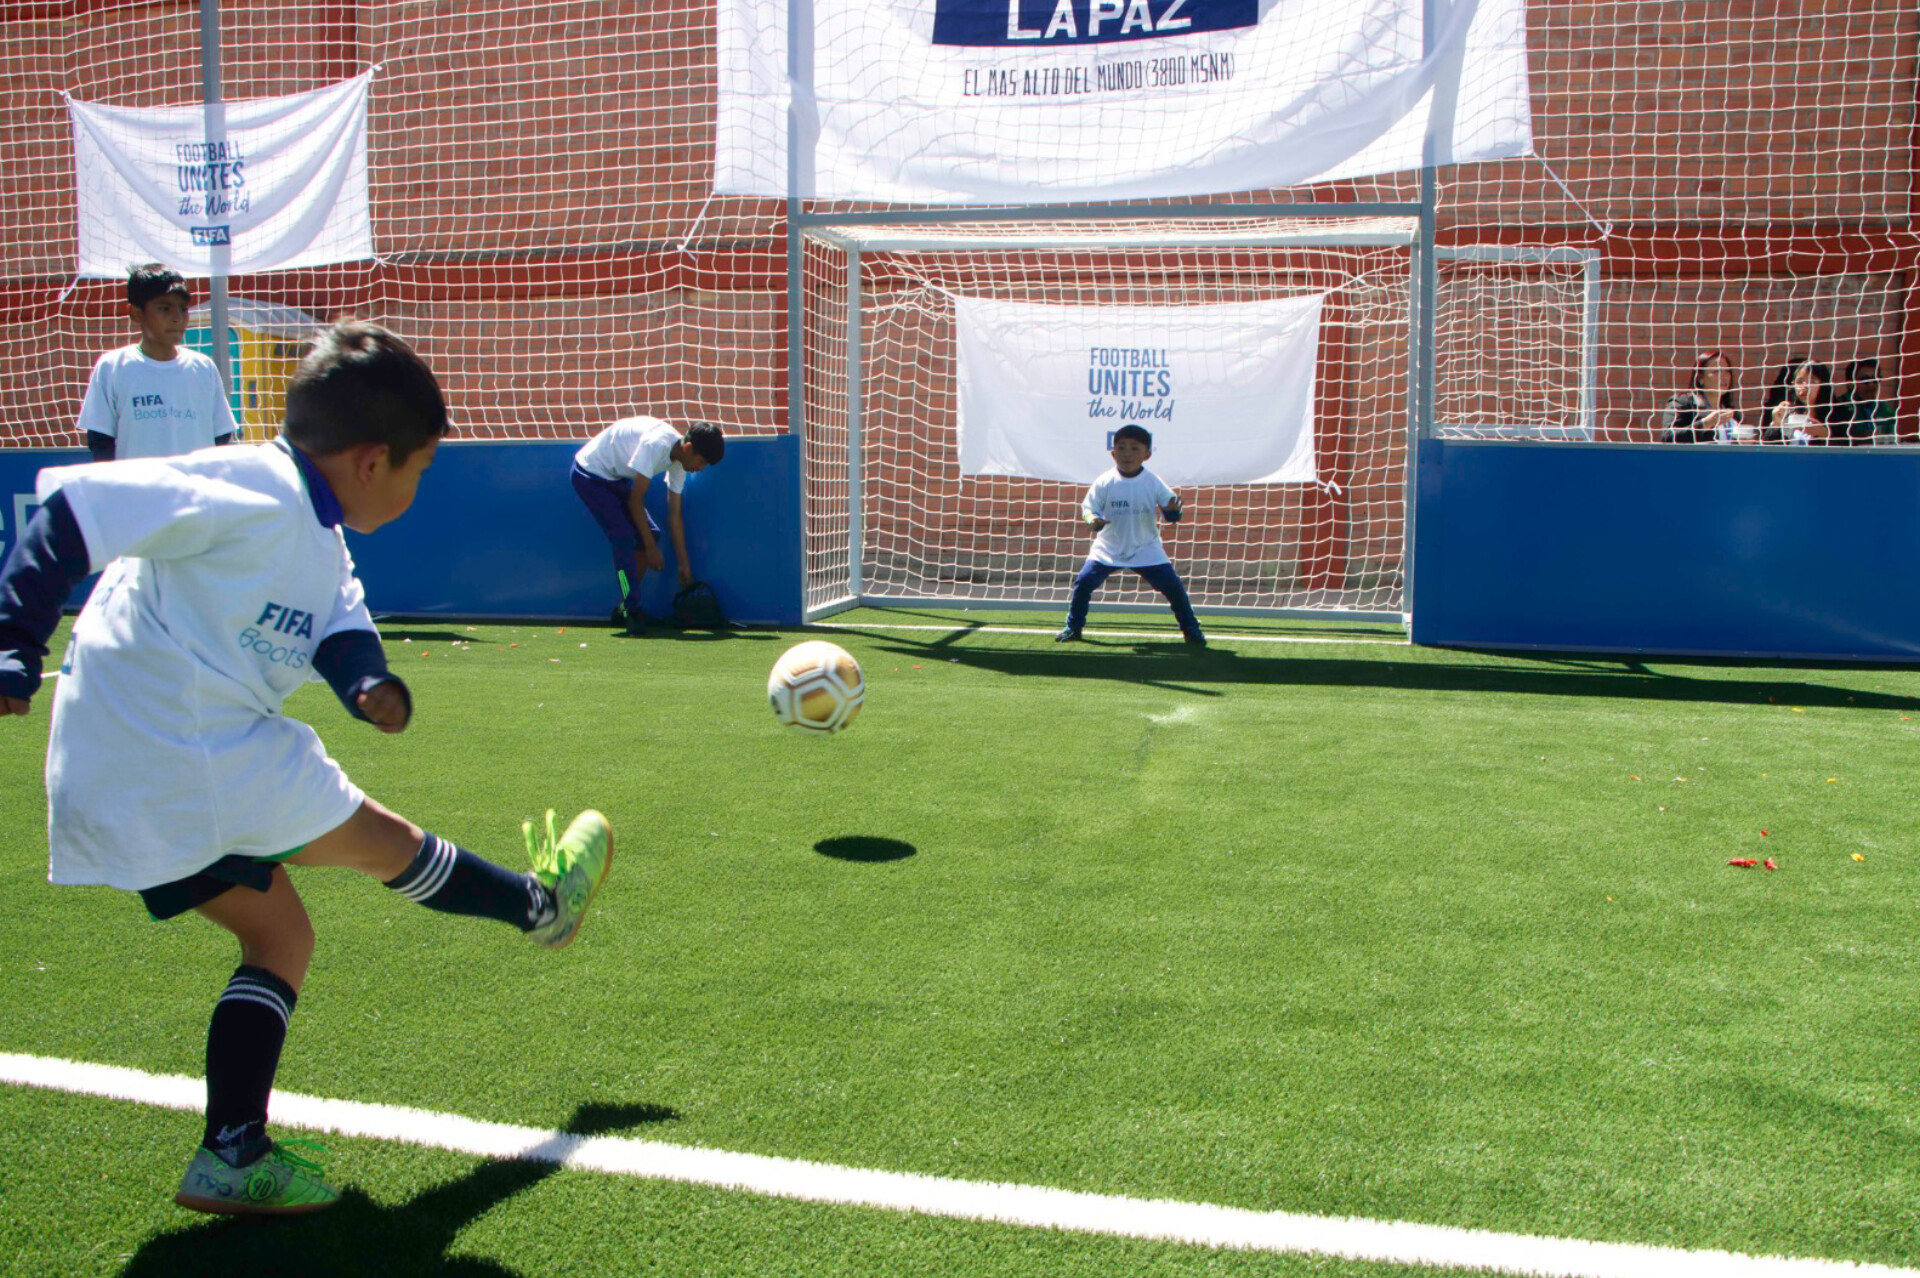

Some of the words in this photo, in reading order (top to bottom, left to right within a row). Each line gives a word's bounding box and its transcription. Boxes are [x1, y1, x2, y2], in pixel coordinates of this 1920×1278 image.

[1007, 0, 1077, 40] LA
[1088, 0, 1193, 37] PAZ
[963, 68, 981, 96] EL
[988, 68, 1017, 96] MAS
[1022, 67, 1060, 96] ALTO
[1063, 66, 1092, 95] DEL
[1096, 60, 1143, 92] MUNDO
[1145, 55, 1186, 88] (3800
[1191, 52, 1235, 84] MSNM)
[176, 140, 245, 162] FOOTBALL
[178, 161, 245, 192] UNITES
[178, 195, 203, 216] the
[204, 189, 250, 216] World
[192, 227, 228, 243] FIFA
[1090, 346, 1170, 368] FOOTBALL
[1087, 368, 1171, 397] UNITES
[132, 394, 164, 408] FIFA
[134, 408, 168, 421] Boots
[169, 406, 182, 419] for
[1086, 397, 1117, 418] the
[1119, 398, 1175, 422] World
[1111, 499, 1130, 509] FIFA
[256, 601, 315, 640] FIFA
[239, 626, 308, 669] Boots
